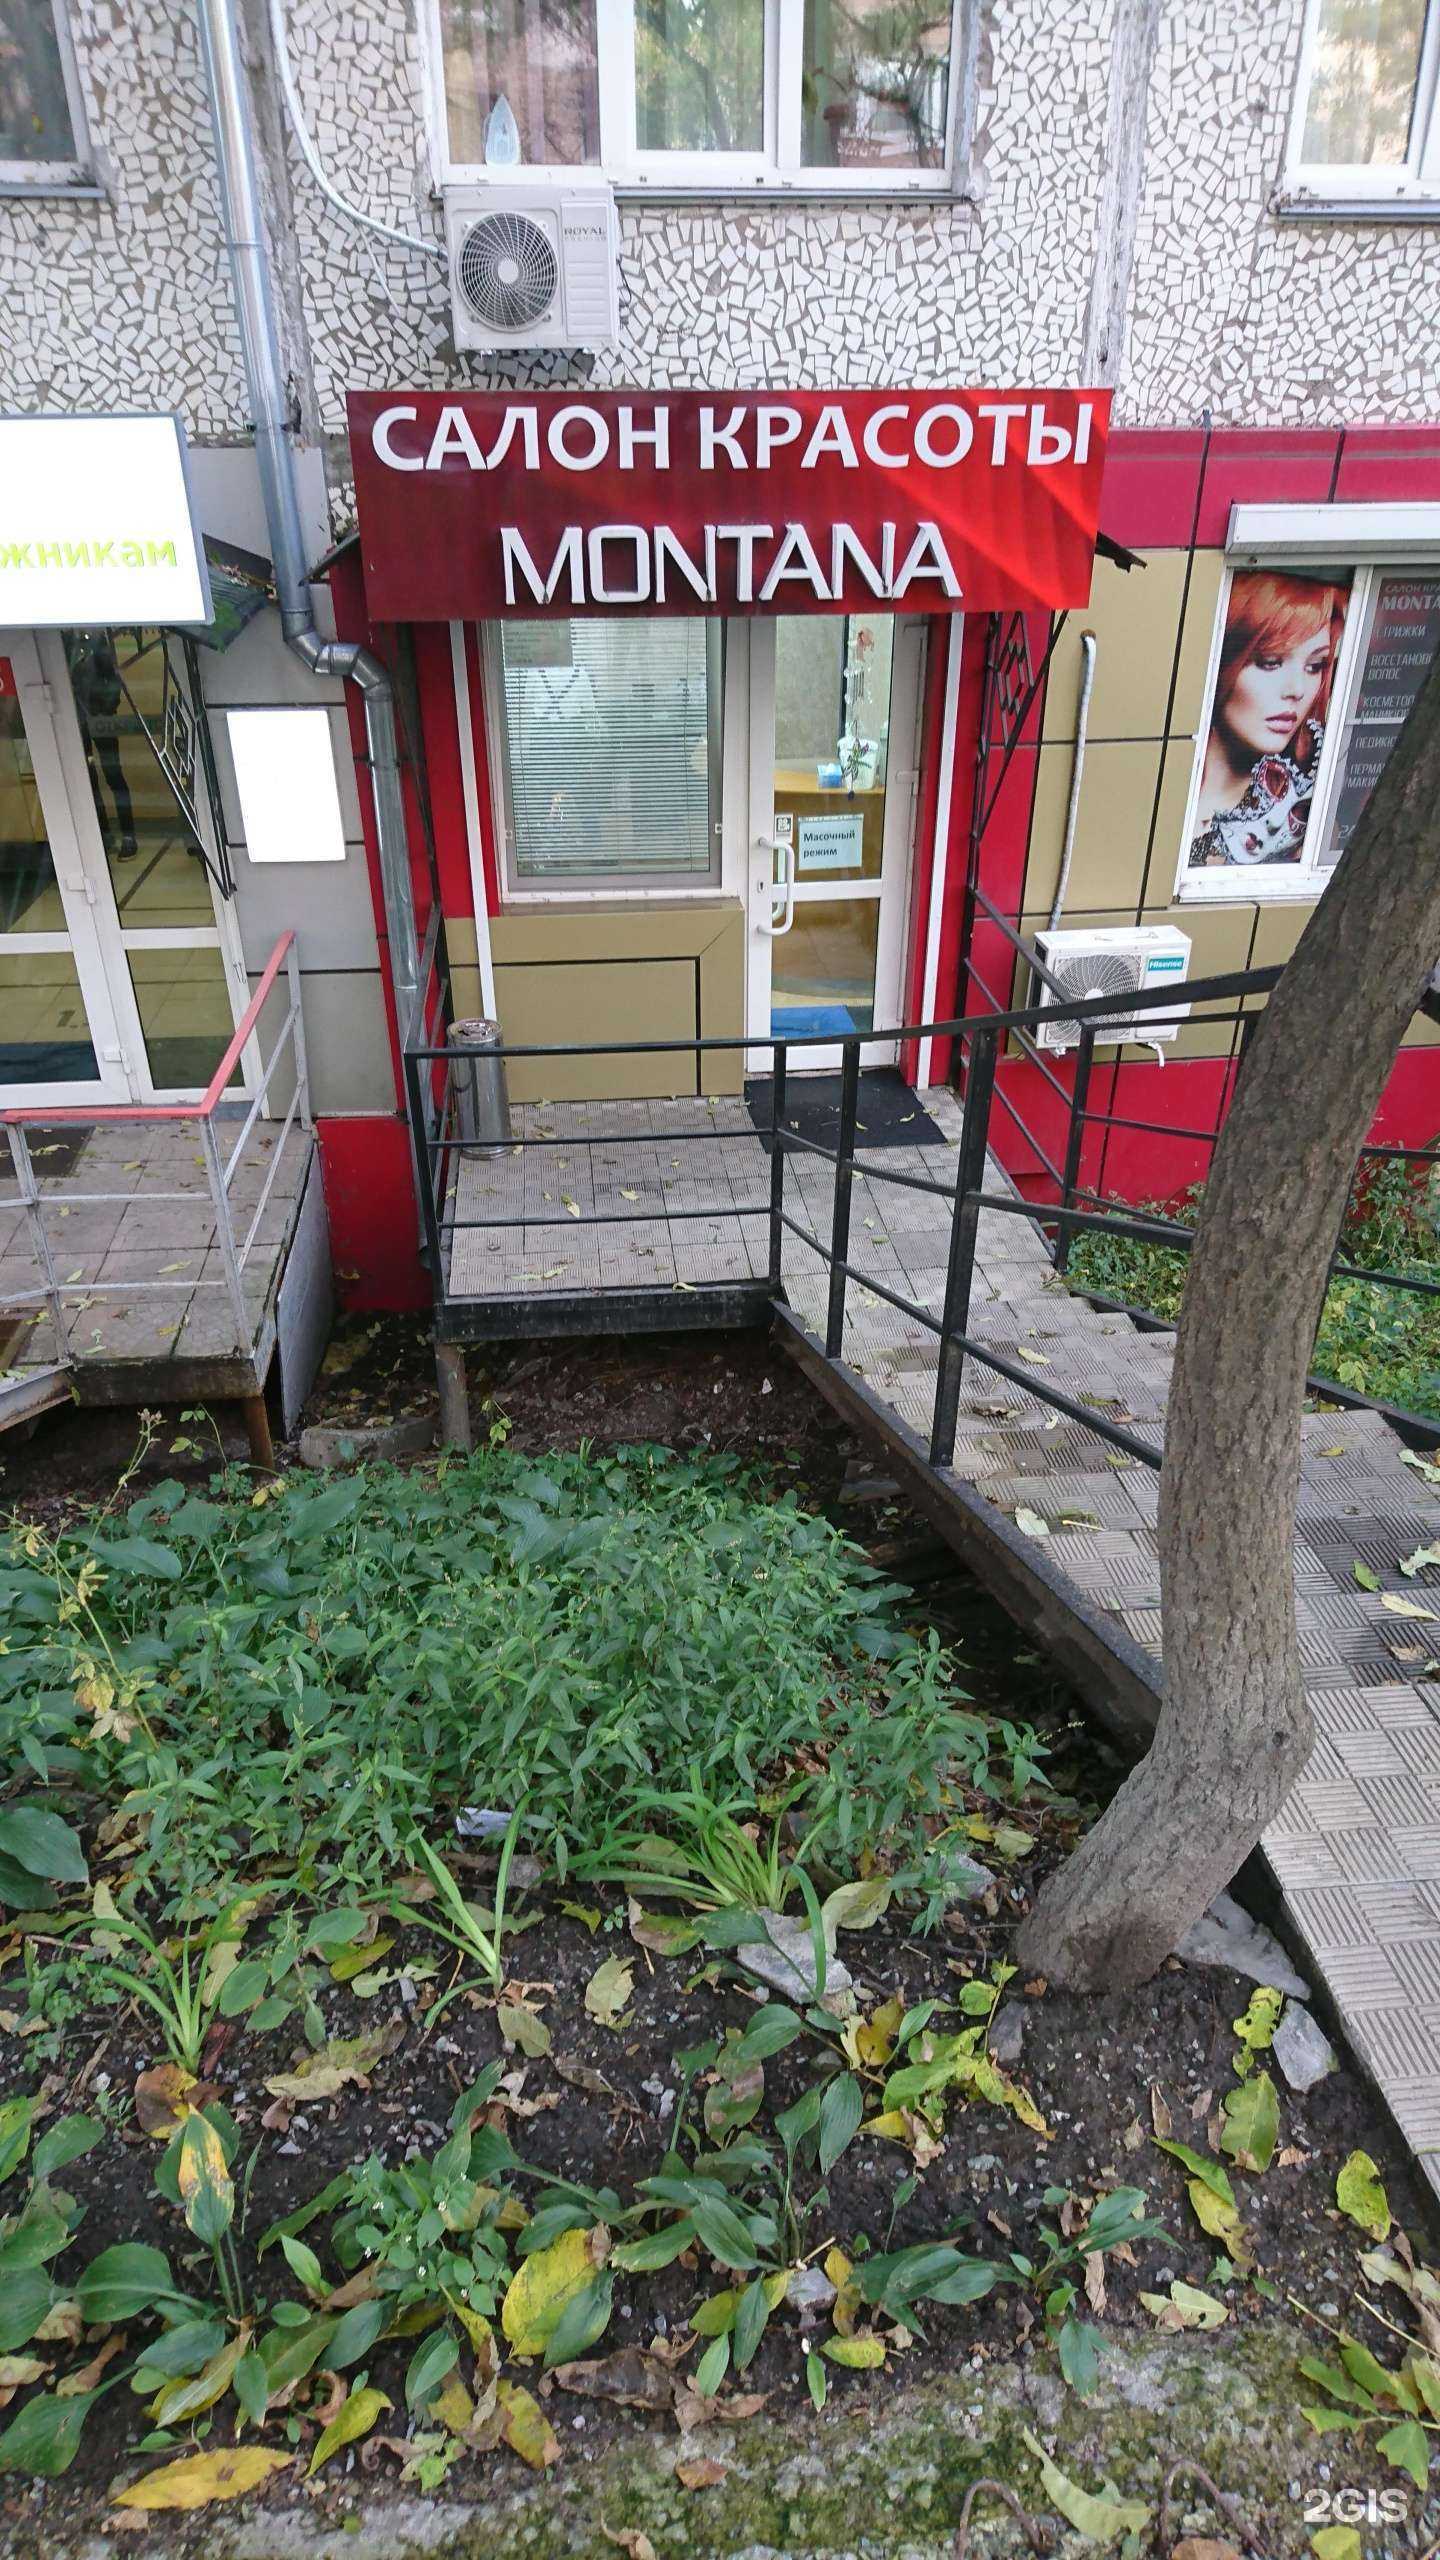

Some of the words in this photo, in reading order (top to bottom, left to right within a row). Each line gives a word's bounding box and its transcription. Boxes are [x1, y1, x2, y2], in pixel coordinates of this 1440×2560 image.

[565, 226, 603, 235] ROYAL
[371, 406, 670, 472] САЛОН
[699, 403, 1093, 469] КРАСОТЫ
[499, 521, 963, 605] MONTANA
[1347, 776, 1379, 789] МАКИ
[803, 830, 856, 842] Масочный
[803, 848, 838, 859] режим
[1150, 960, 1182, 969] Hisense
